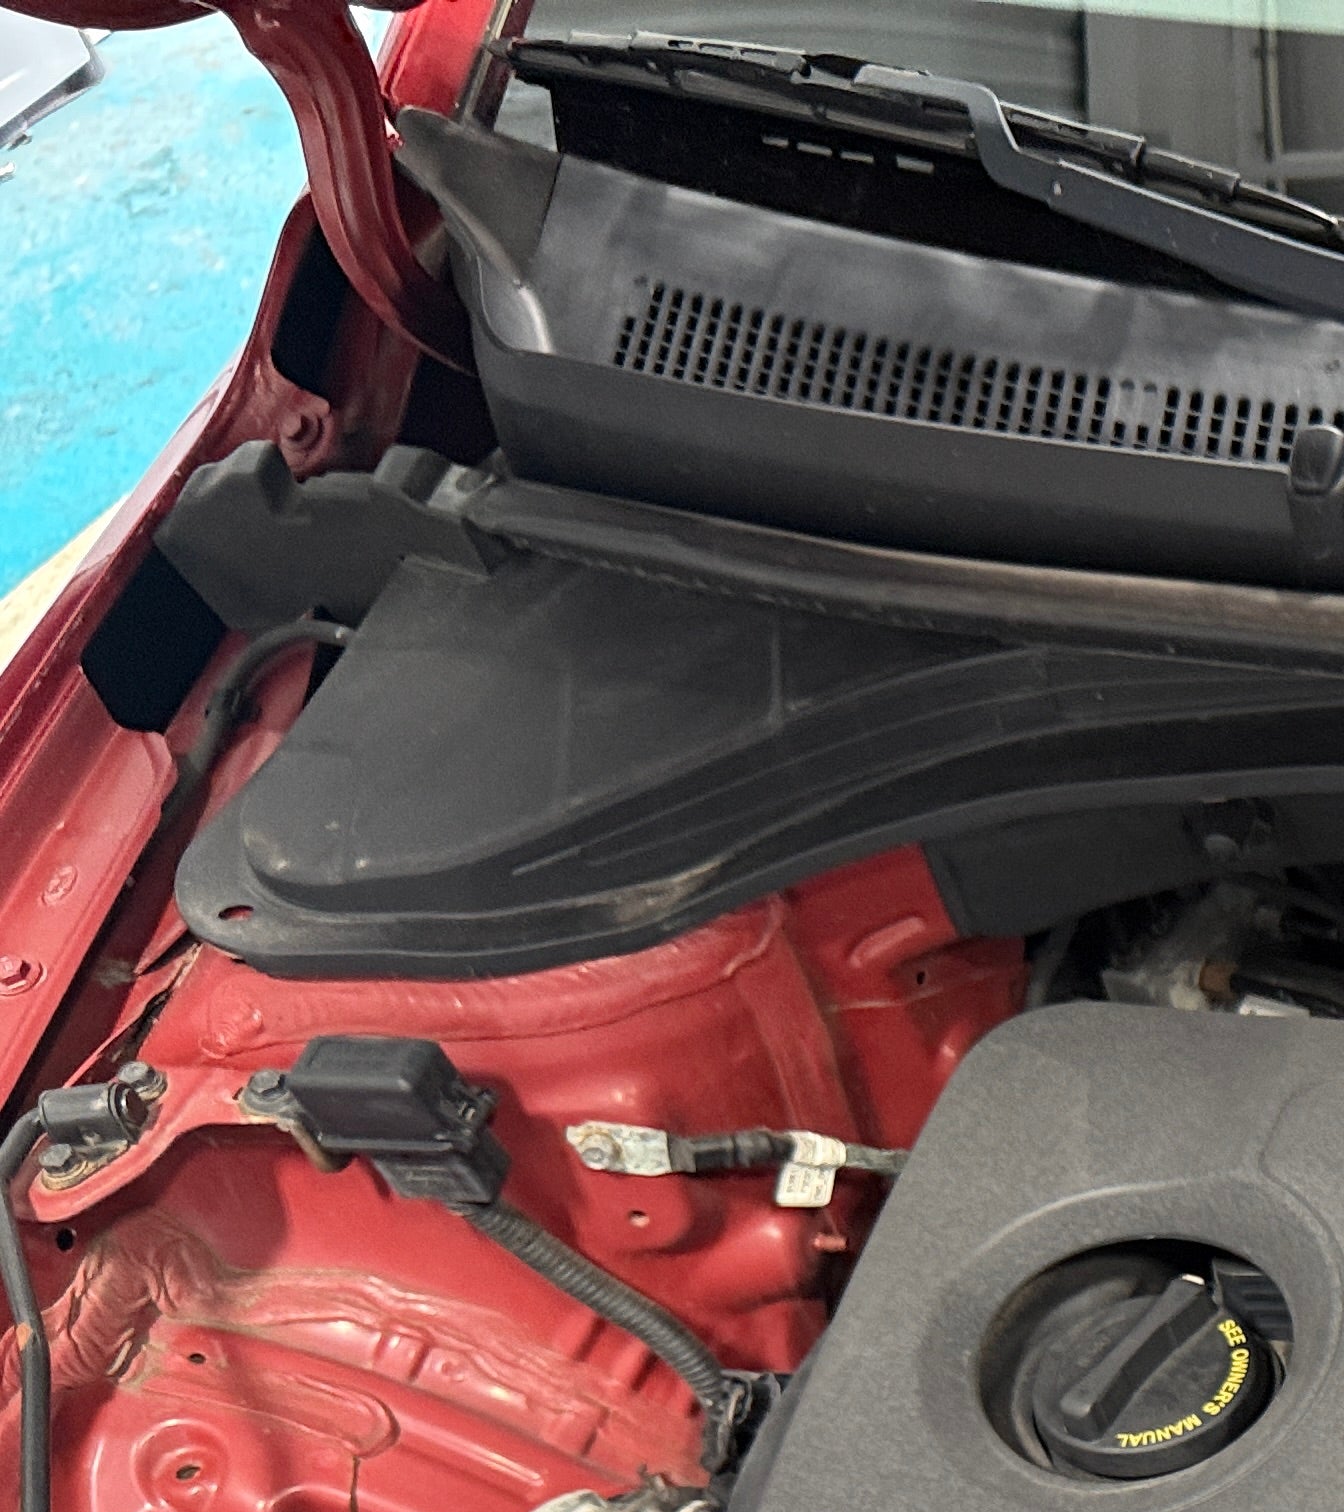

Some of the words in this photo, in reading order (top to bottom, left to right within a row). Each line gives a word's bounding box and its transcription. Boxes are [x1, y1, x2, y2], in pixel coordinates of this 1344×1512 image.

[1219, 1320, 1246, 1347] SEE
[1202, 1348, 1250, 1416] OWNER'S
[1117, 1414, 1202, 1447] MANUAL
